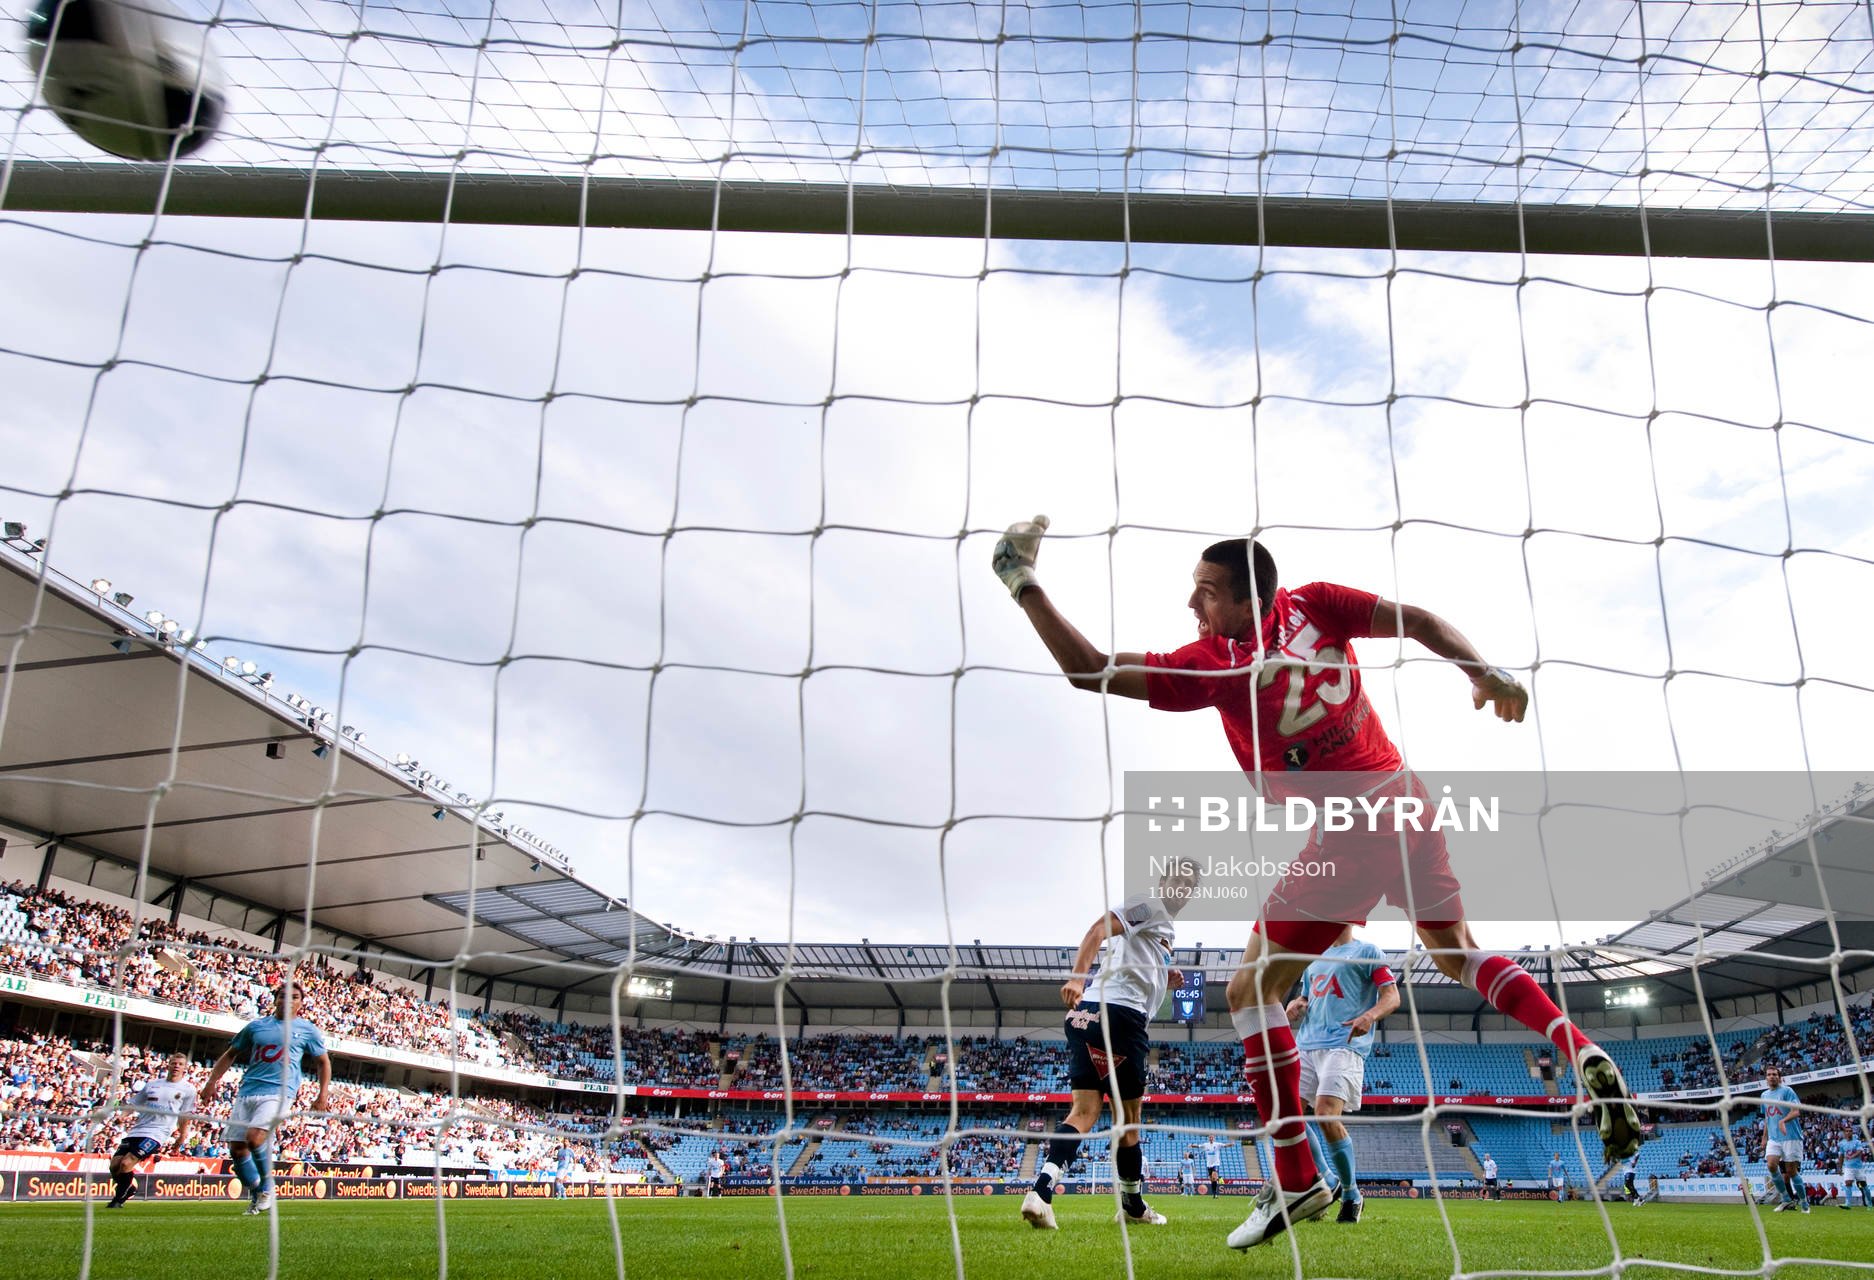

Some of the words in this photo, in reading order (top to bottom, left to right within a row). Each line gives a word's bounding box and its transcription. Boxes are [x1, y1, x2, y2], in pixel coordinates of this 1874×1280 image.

[0, 977, 28, 992] AB
[1175, 989, 1200, 999] 05:45
[84, 992, 127, 1010] PEAB
[175, 1009, 211, 1025] PEAB
[583, 1083, 609, 1092] PEAB
[27, 1176, 118, 1198] Swedbank
[154, 1178, 227, 1198] Swedbank
[273, 1180, 314, 1197] edbank
[336, 1181, 386, 1197] Swedbank
[465, 1182, 500, 1197] Swedbank
[513, 1183, 545, 1196] Swedbank
[789, 1185, 839, 1196] Swedbank
[861, 1185, 910, 1195] Swedbank
[932, 1185, 982, 1195] Swdbank
[1219, 1185, 1260, 1195] Swedban
[1359, 1187, 1408, 1197] Swedbank
[1500, 1190, 1549, 1200] Swedbank
